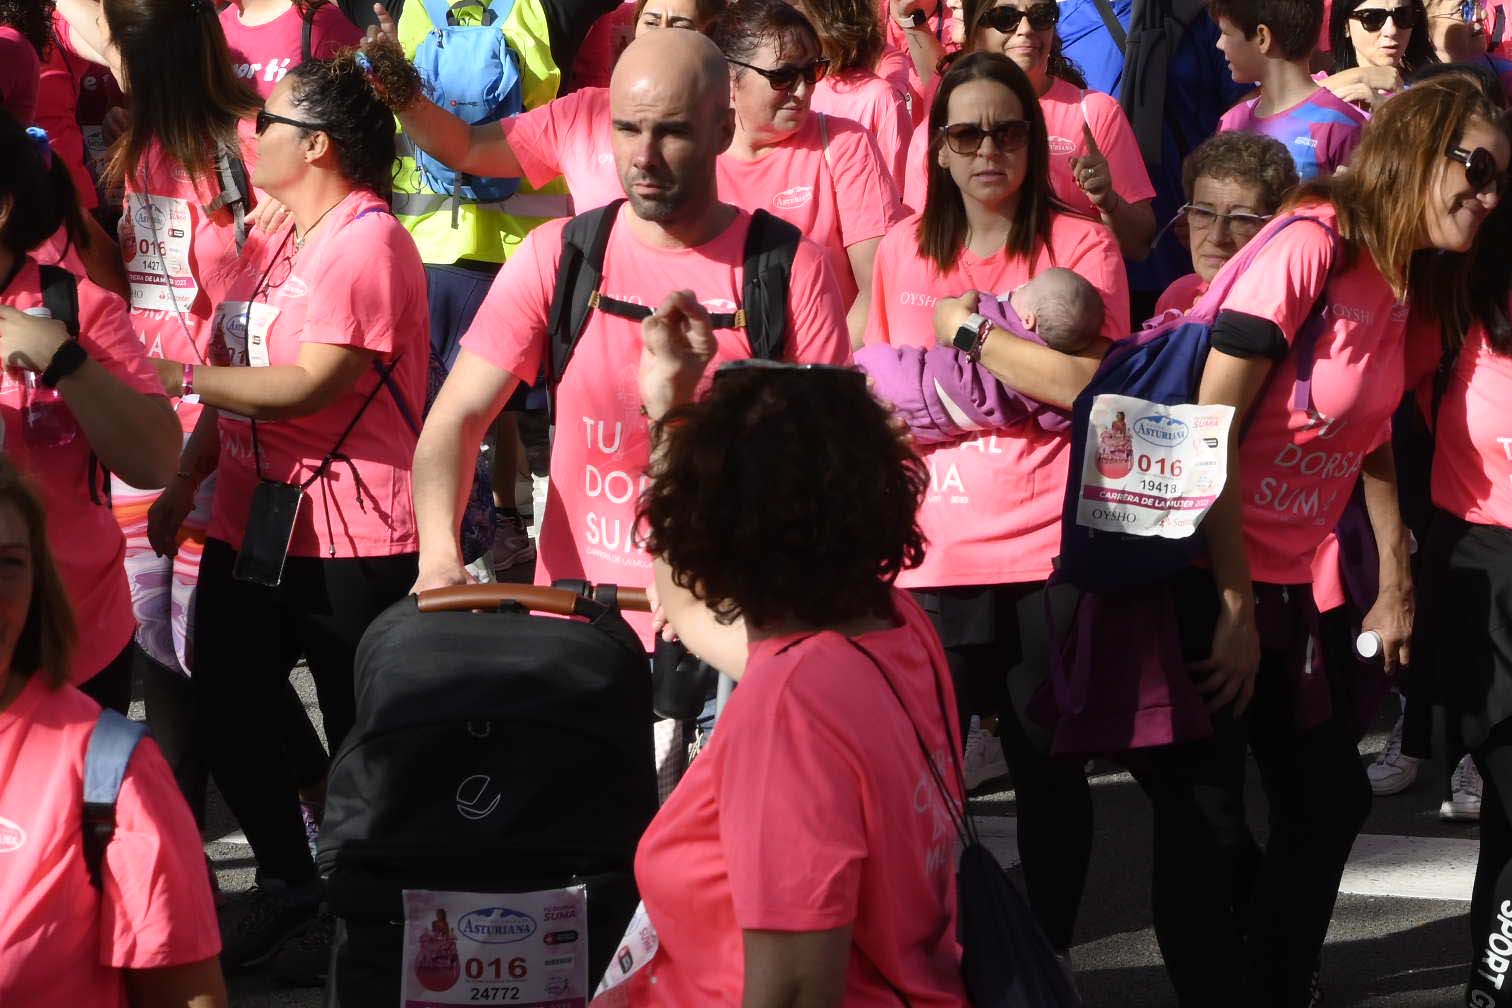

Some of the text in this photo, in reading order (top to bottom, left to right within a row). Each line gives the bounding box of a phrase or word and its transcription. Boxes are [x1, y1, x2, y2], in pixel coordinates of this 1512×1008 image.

[139, 239, 167, 256] 016
[582, 416, 622, 454] TU
[1137, 453, 1183, 478] 016
[1141, 479, 1177, 495] 19418
[1140, 497, 1154, 507] DE
[1092, 509, 1137, 523] OYSHO
[464, 919, 531, 936] ASTURIANA
[464, 956, 529, 981] 016
[470, 986, 520, 1001] 24772
